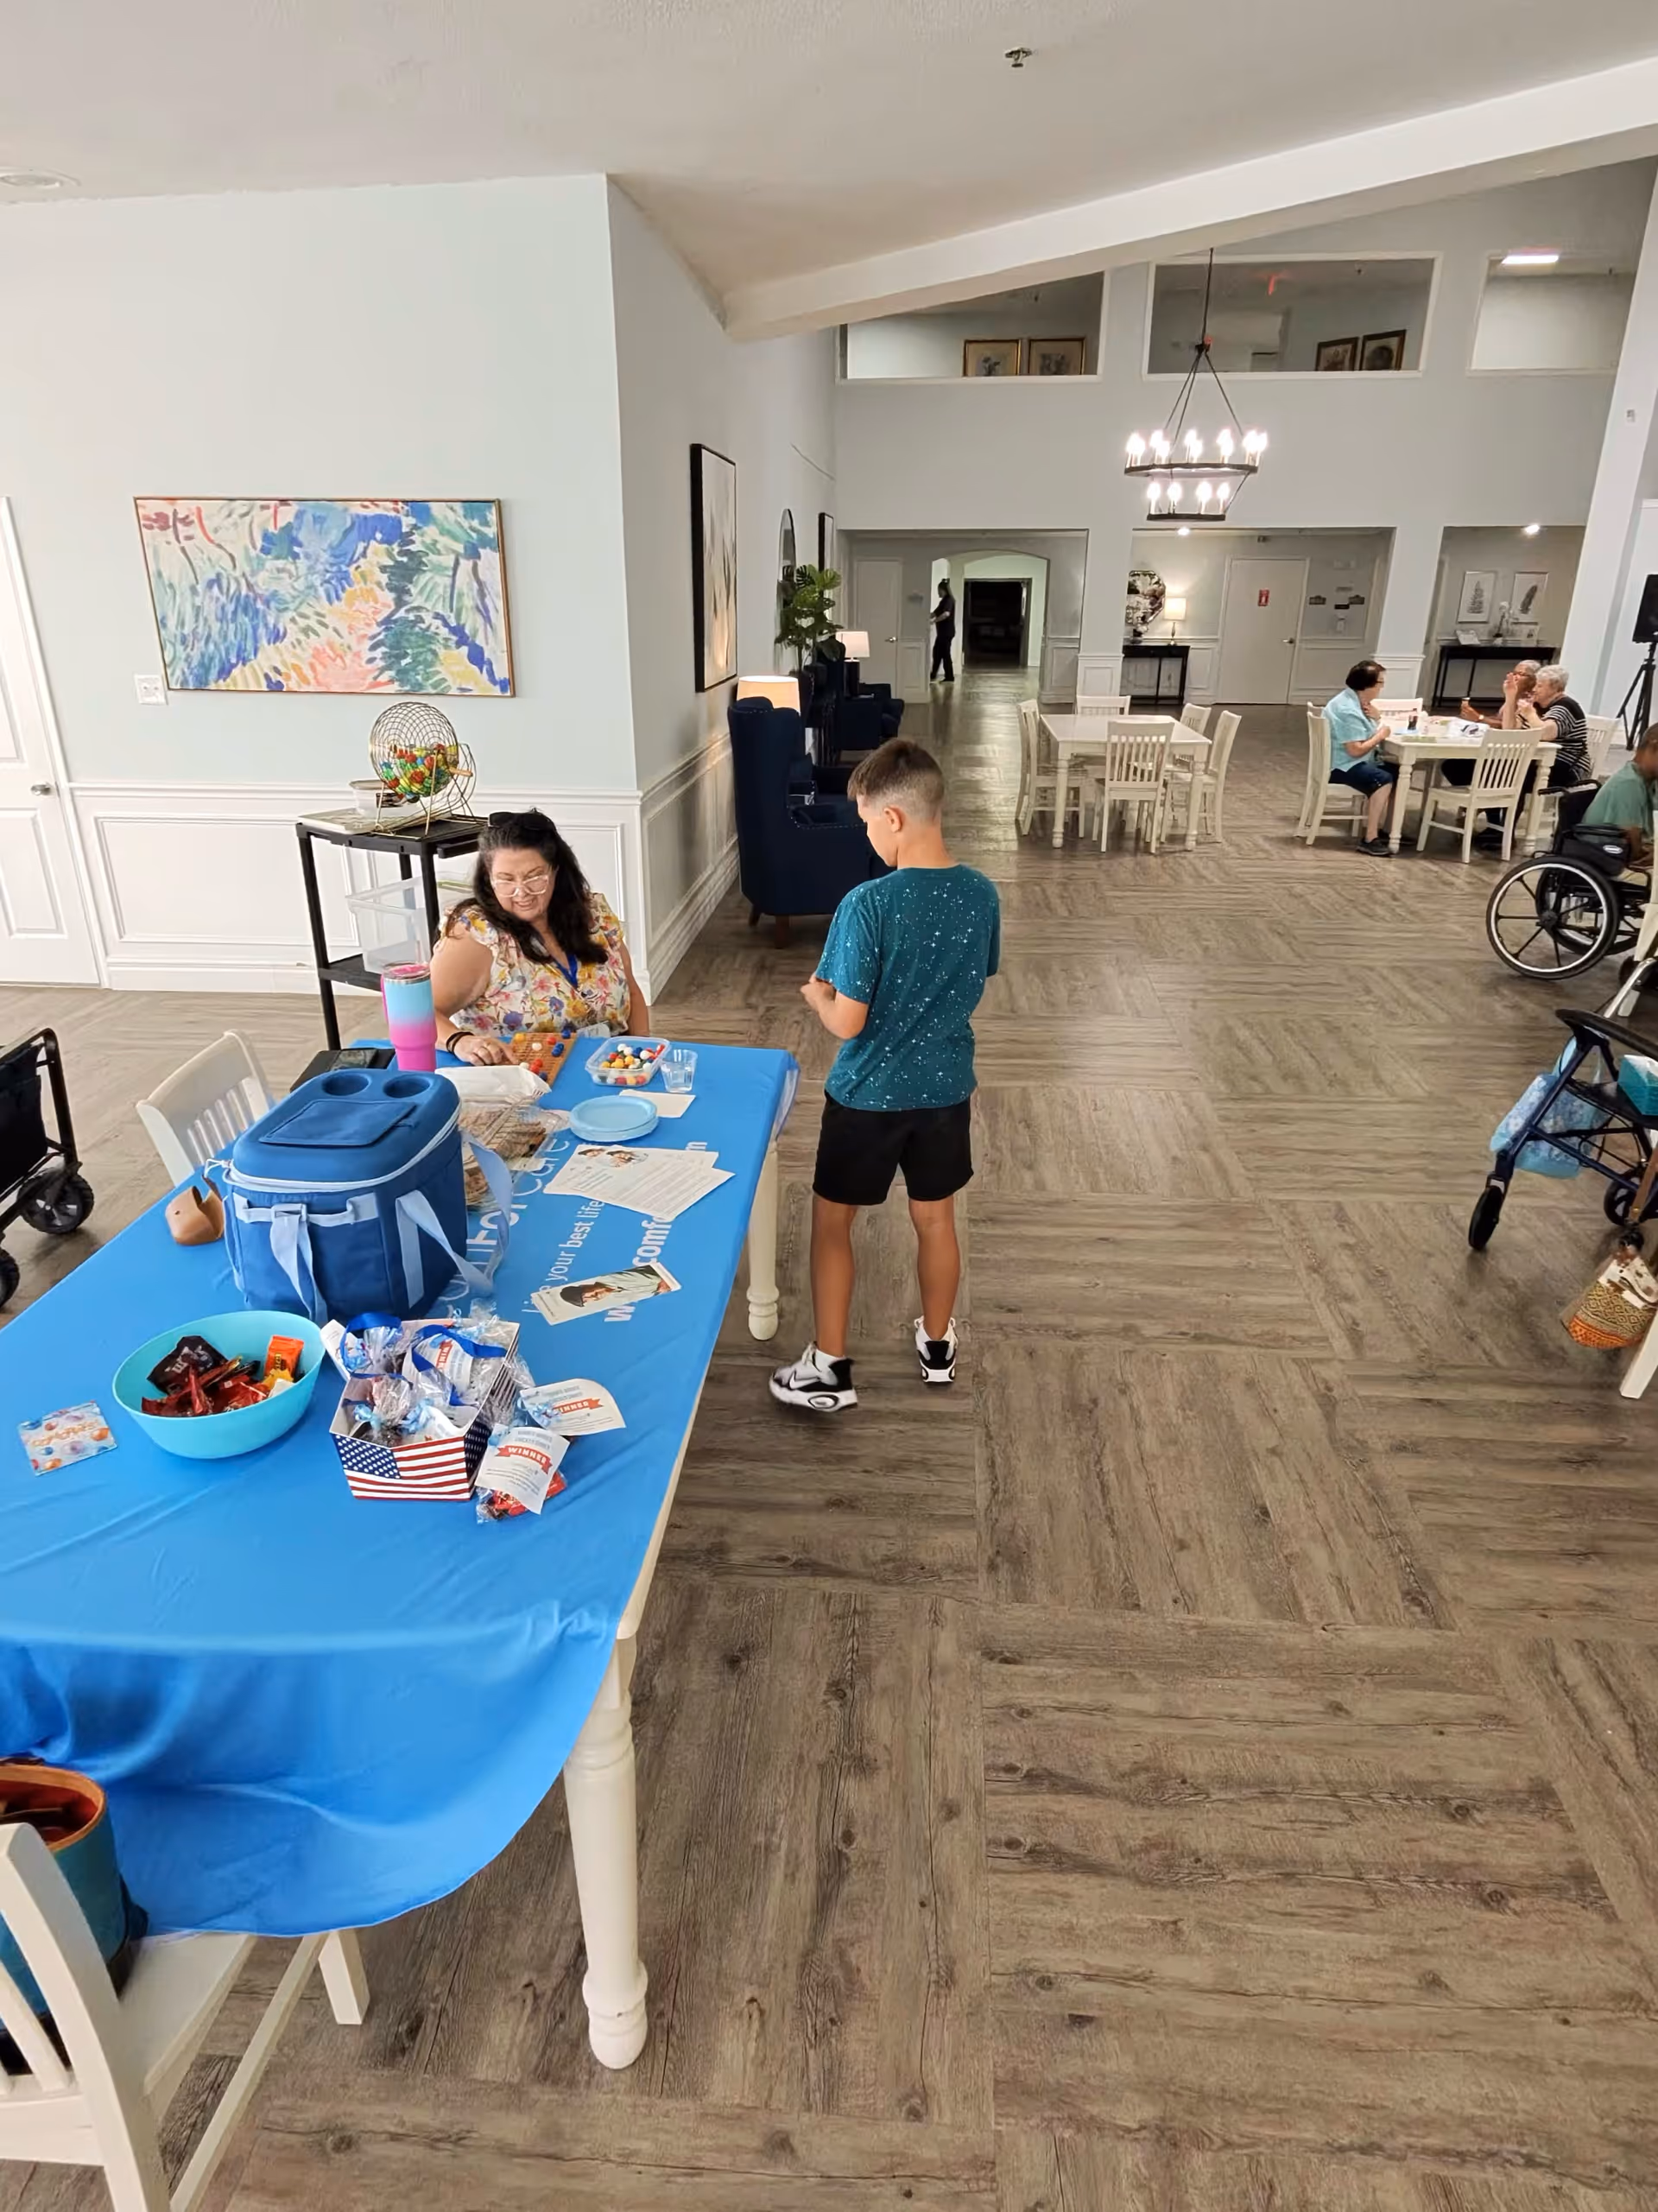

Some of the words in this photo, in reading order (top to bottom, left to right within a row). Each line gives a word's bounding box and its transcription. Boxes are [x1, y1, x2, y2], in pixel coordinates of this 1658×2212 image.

[559, 1220, 595, 1248] best
[546, 1252, 577, 1282] your
[508, 1447, 547, 1465] WINNER
